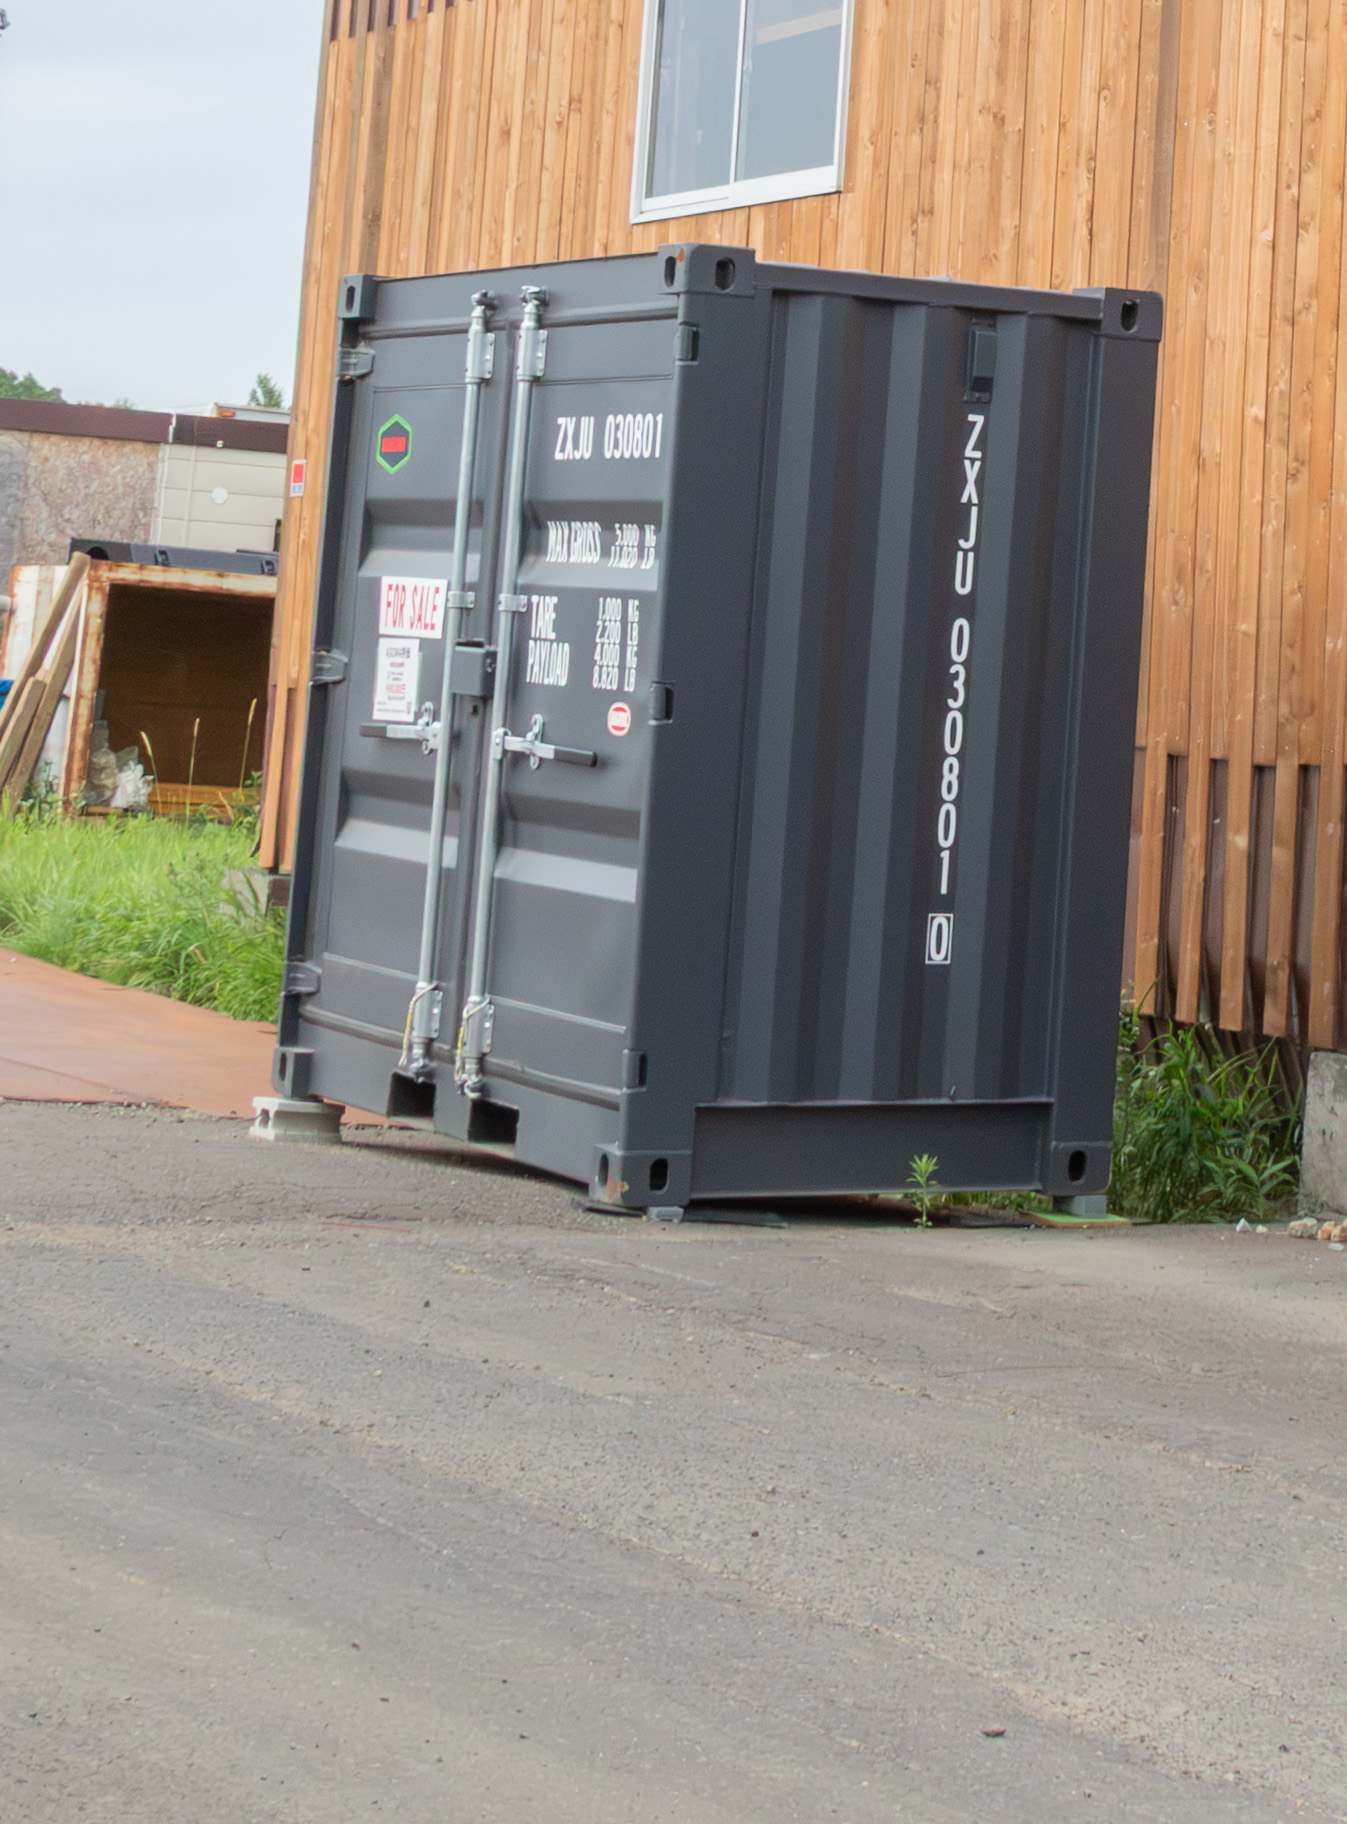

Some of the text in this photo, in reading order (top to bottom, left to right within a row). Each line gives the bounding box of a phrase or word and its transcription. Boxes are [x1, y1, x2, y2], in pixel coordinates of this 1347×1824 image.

[554, 413, 663, 460] ZXJU 030801
[952, 414, 986, 595] ZXJU
[545, 521, 568, 562] MAX
[569, 521, 602, 564] GROSS
[385, 584, 440, 631] FOR SALE
[531, 595, 559, 640] TARE
[526, 640, 570, 686] PAYLOAD
[936, 619, 970, 895] 030801
